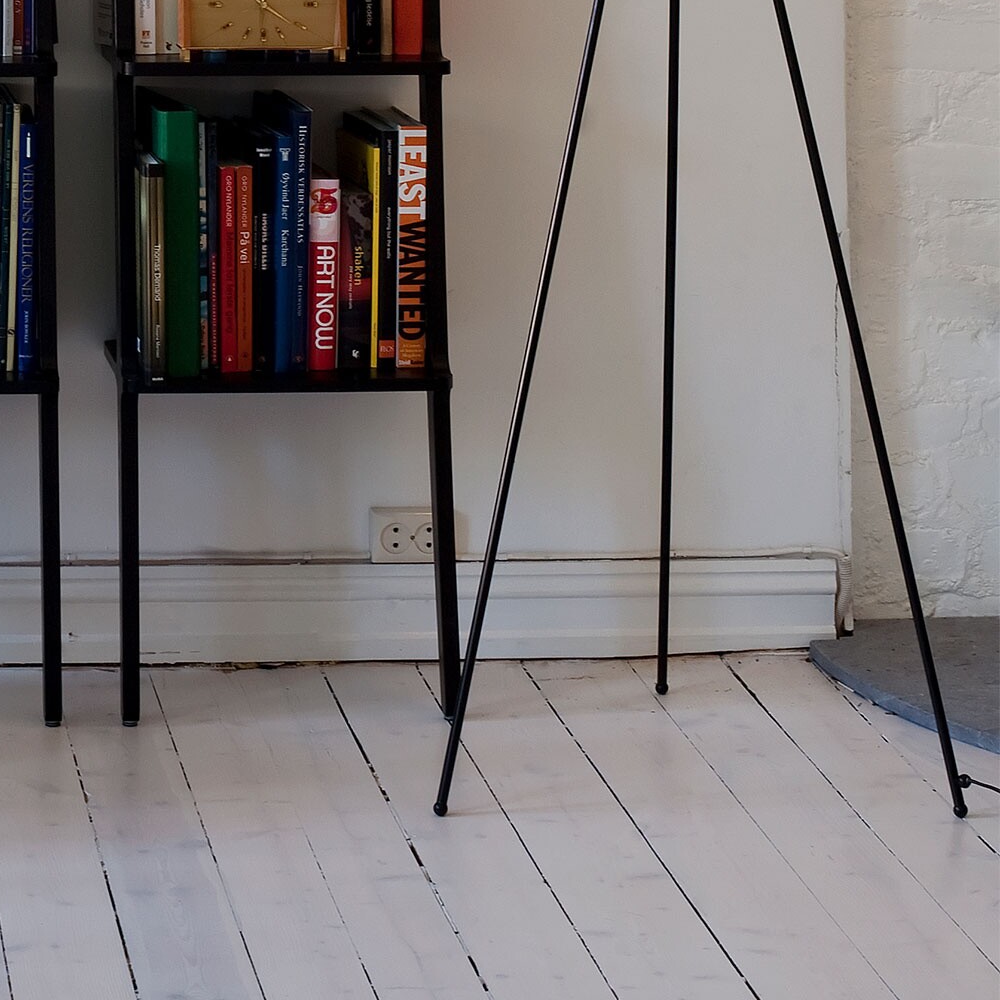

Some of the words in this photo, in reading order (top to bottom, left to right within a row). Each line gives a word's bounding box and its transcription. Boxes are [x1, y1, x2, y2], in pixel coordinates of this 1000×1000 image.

[365, 3, 373, 27] ledelse
[297, 125, 307, 173] HISTORISK
[279, 172, 290, 201] Øyvind
[399, 128, 427, 219] LEAST
[22, 164, 34, 223] VERDENS
[281, 203, 290, 219] Jaer
[296, 177, 305, 243] VERDENSATLAS
[154, 243, 162, 270] Thomas
[240, 231, 250, 245] På
[240, 248, 249, 264] vei
[281, 229, 290, 266] Karchana
[21, 228, 34, 304] RELIGIONER
[315, 245, 335, 288] ART
[354, 246, 364, 285] shaken
[398, 220, 427, 340] WANTED
[154, 272, 162, 301] Demand
[315, 292, 335, 349] NOW
